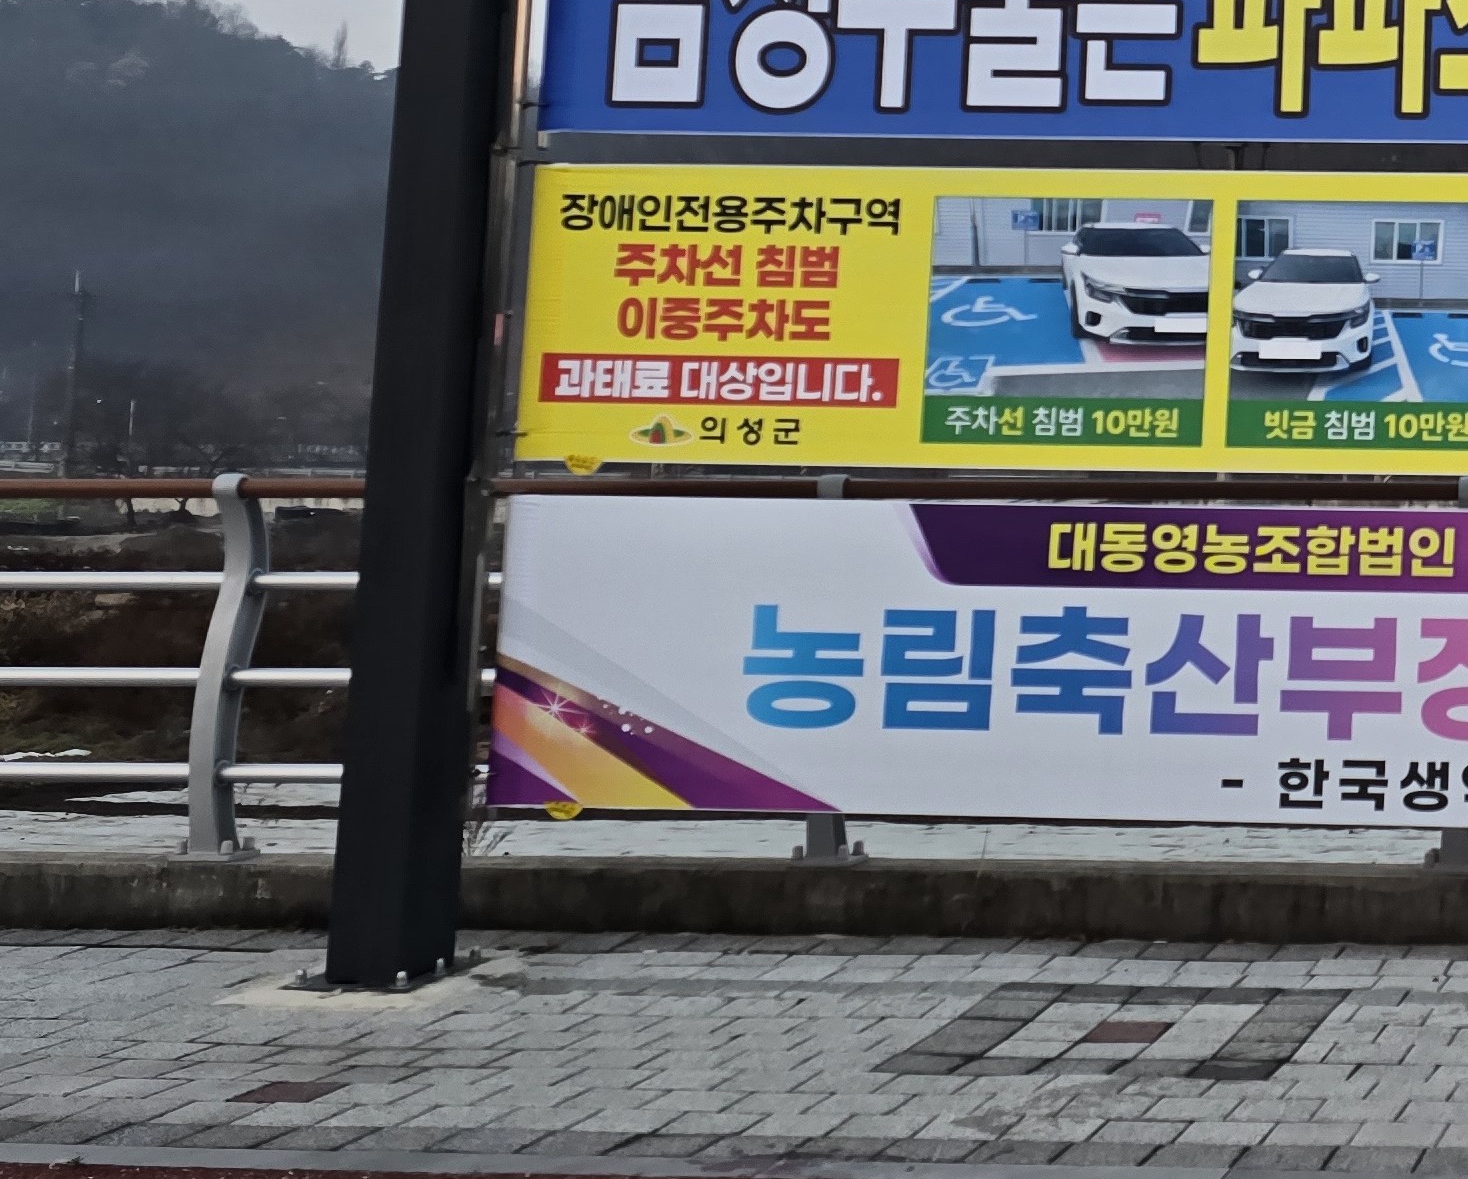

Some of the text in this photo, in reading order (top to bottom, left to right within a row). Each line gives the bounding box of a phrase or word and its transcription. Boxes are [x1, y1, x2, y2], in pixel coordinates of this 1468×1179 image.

[560, 193, 902, 236] 장애인전용주차구역
[614, 242, 841, 289] 주차선 침범
[617, 296, 832, 342] 이중주차도
[554, 358, 883, 403] 과태료 대상입니다.
[945, 406, 1180, 439] 주차선 침범 10만원
[1264, 410, 1317, 440] 빗금
[1325, 410, 1377, 441] 침범
[1046, 520, 1456, 579] 대동영농조합법인
